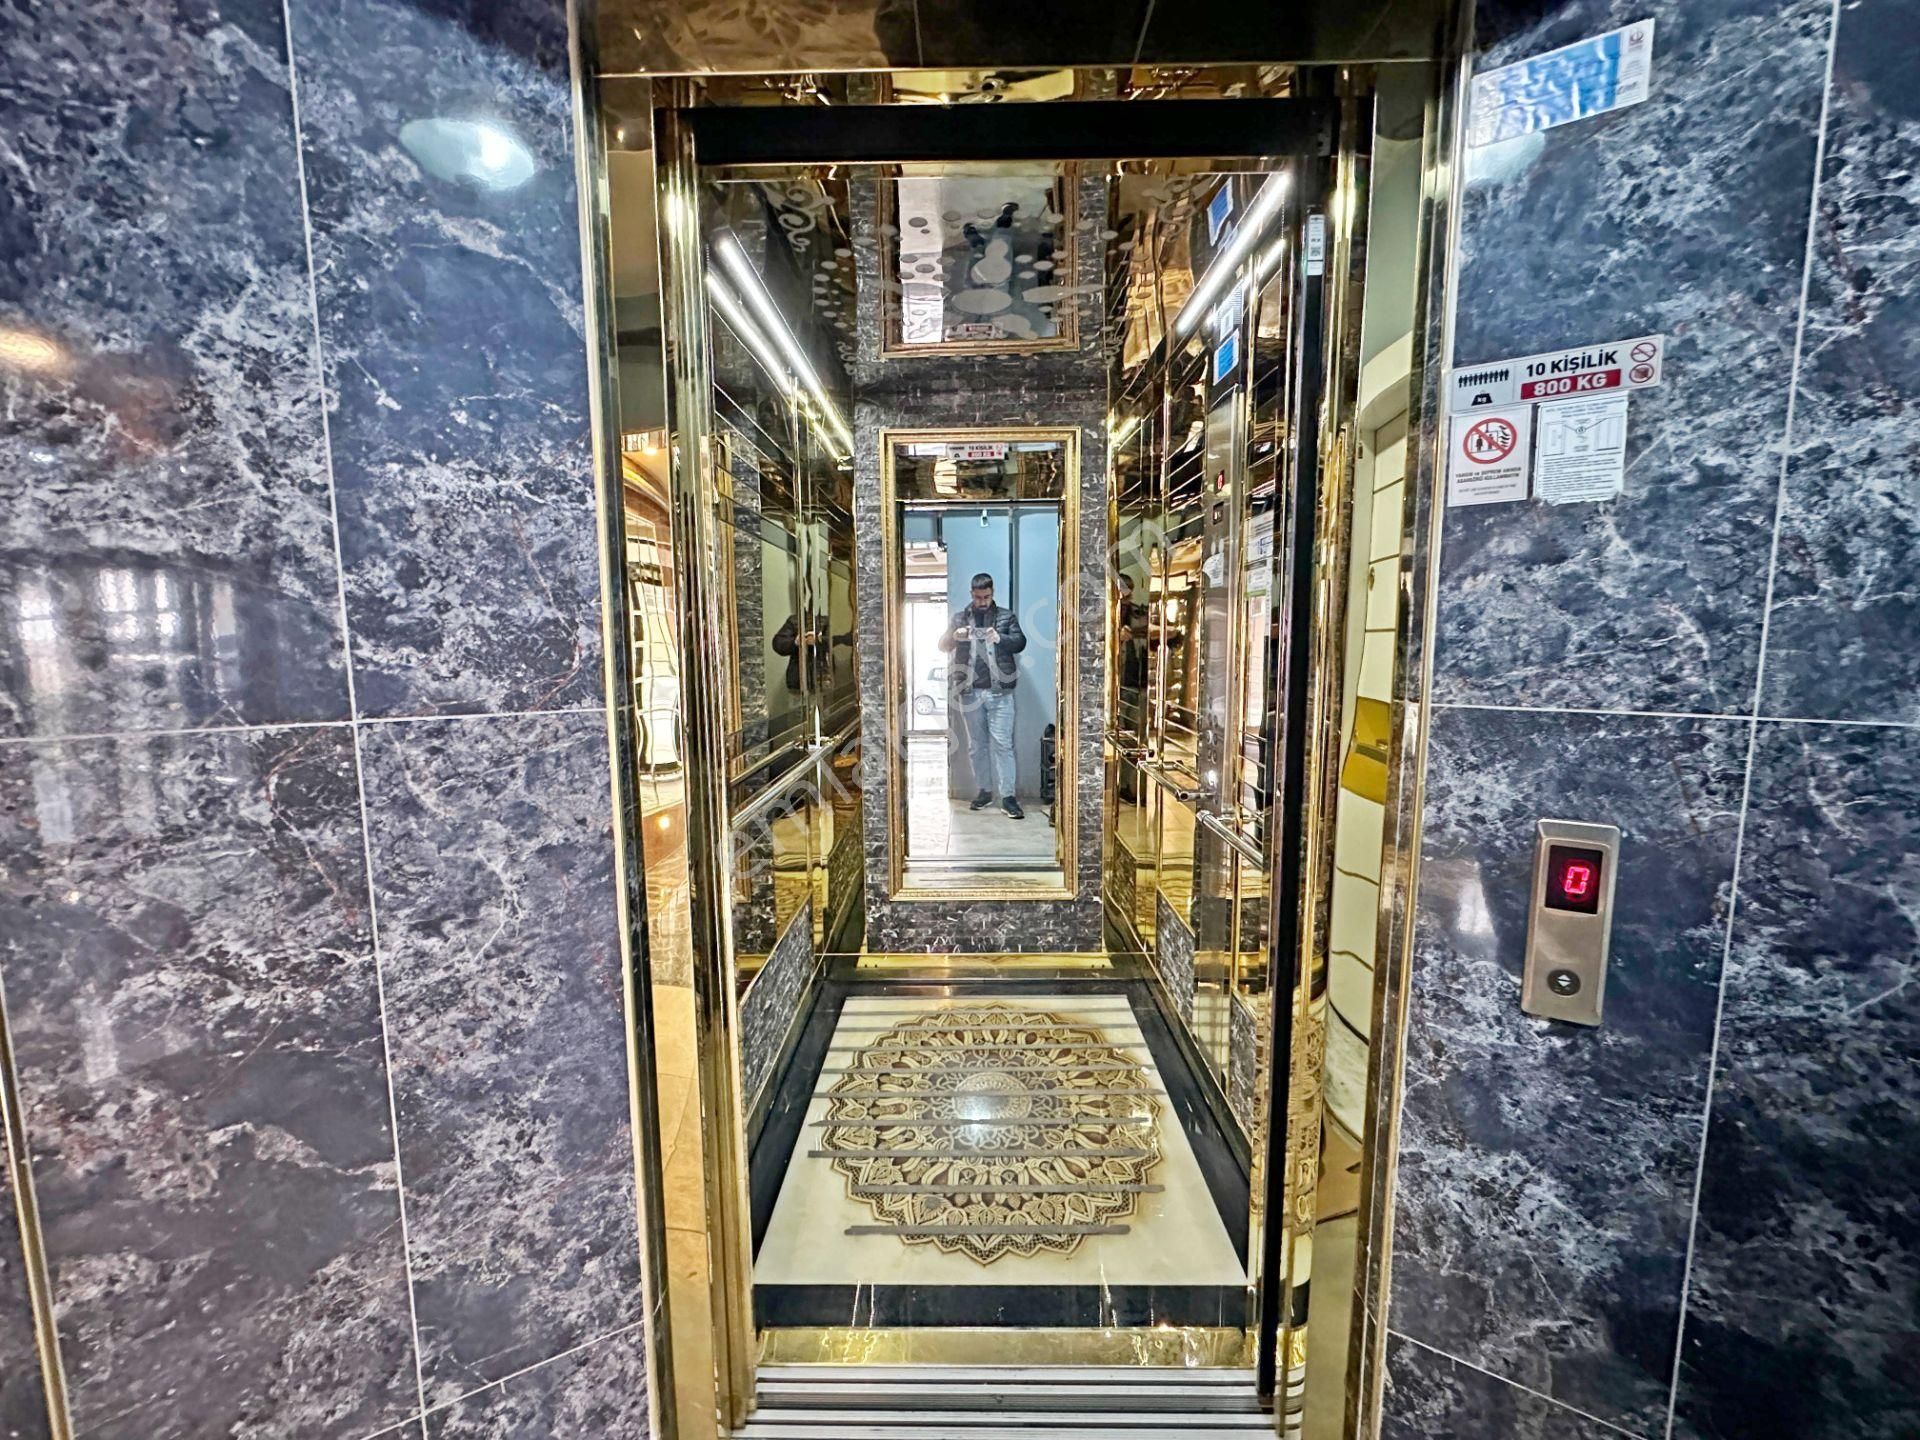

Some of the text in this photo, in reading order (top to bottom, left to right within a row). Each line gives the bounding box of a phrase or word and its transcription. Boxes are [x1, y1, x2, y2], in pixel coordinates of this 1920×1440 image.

[1526, 349, 1618, 377] 10 KİŞİLİK
[1534, 373, 1608, 397] 800 KG
[1564, 866, 1590, 894] 0
